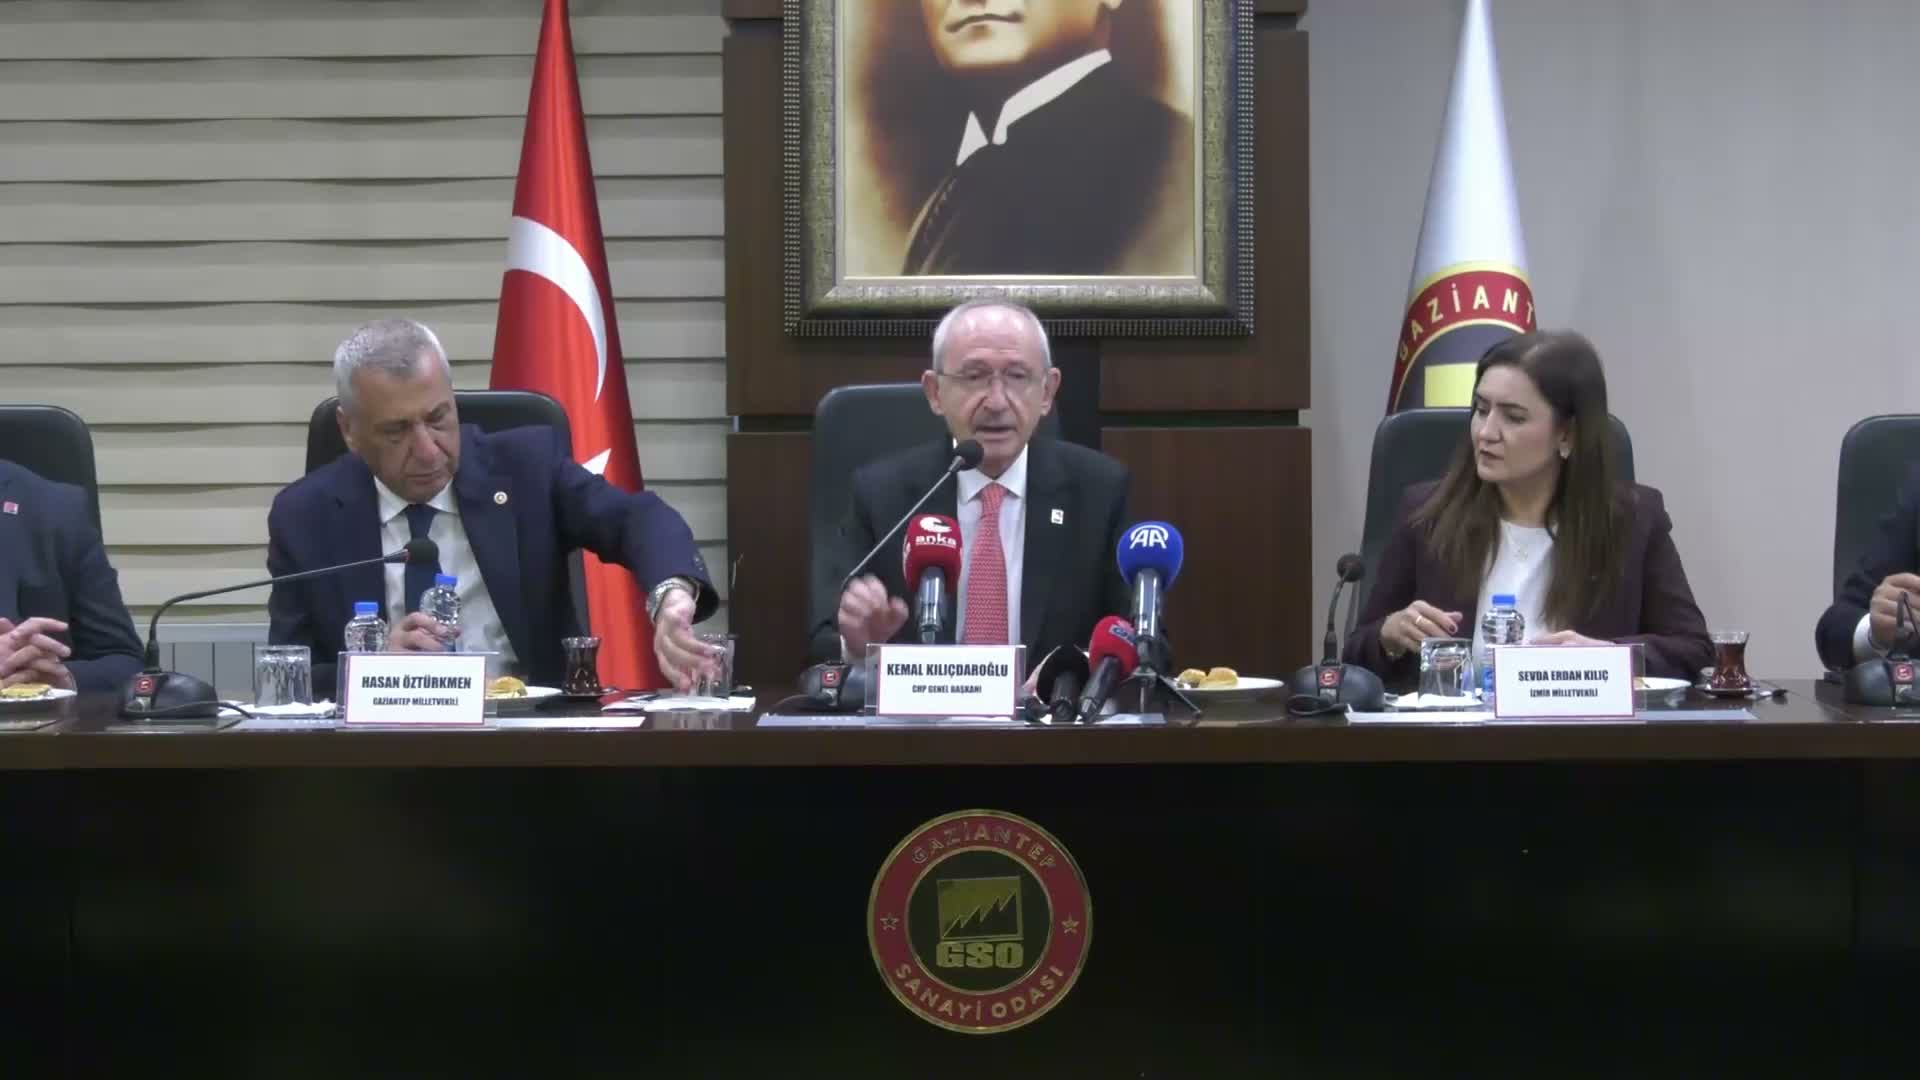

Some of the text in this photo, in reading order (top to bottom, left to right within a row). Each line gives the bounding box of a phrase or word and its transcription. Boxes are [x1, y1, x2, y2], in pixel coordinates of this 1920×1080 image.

[915, 533, 957, 546] anka
[1129, 528, 1168, 549] AA
[887, 661, 1008, 678] KEMAL KILIÇDAROĞLU
[1518, 669, 1609, 683] SEVDA ERDAN KILIÇ
[362, 674, 472, 689] HASAN ÖZTÜRKMEN
[912, 684, 982, 694] CHP GENEL BAŞKANI
[373, 697, 411, 706] GAZİANTEP
[911, 822, 1056, 868] GAZİANTEP
[936, 942, 1024, 968] GSO
[896, 963, 1064, 1021] SANAYİ ODASI
